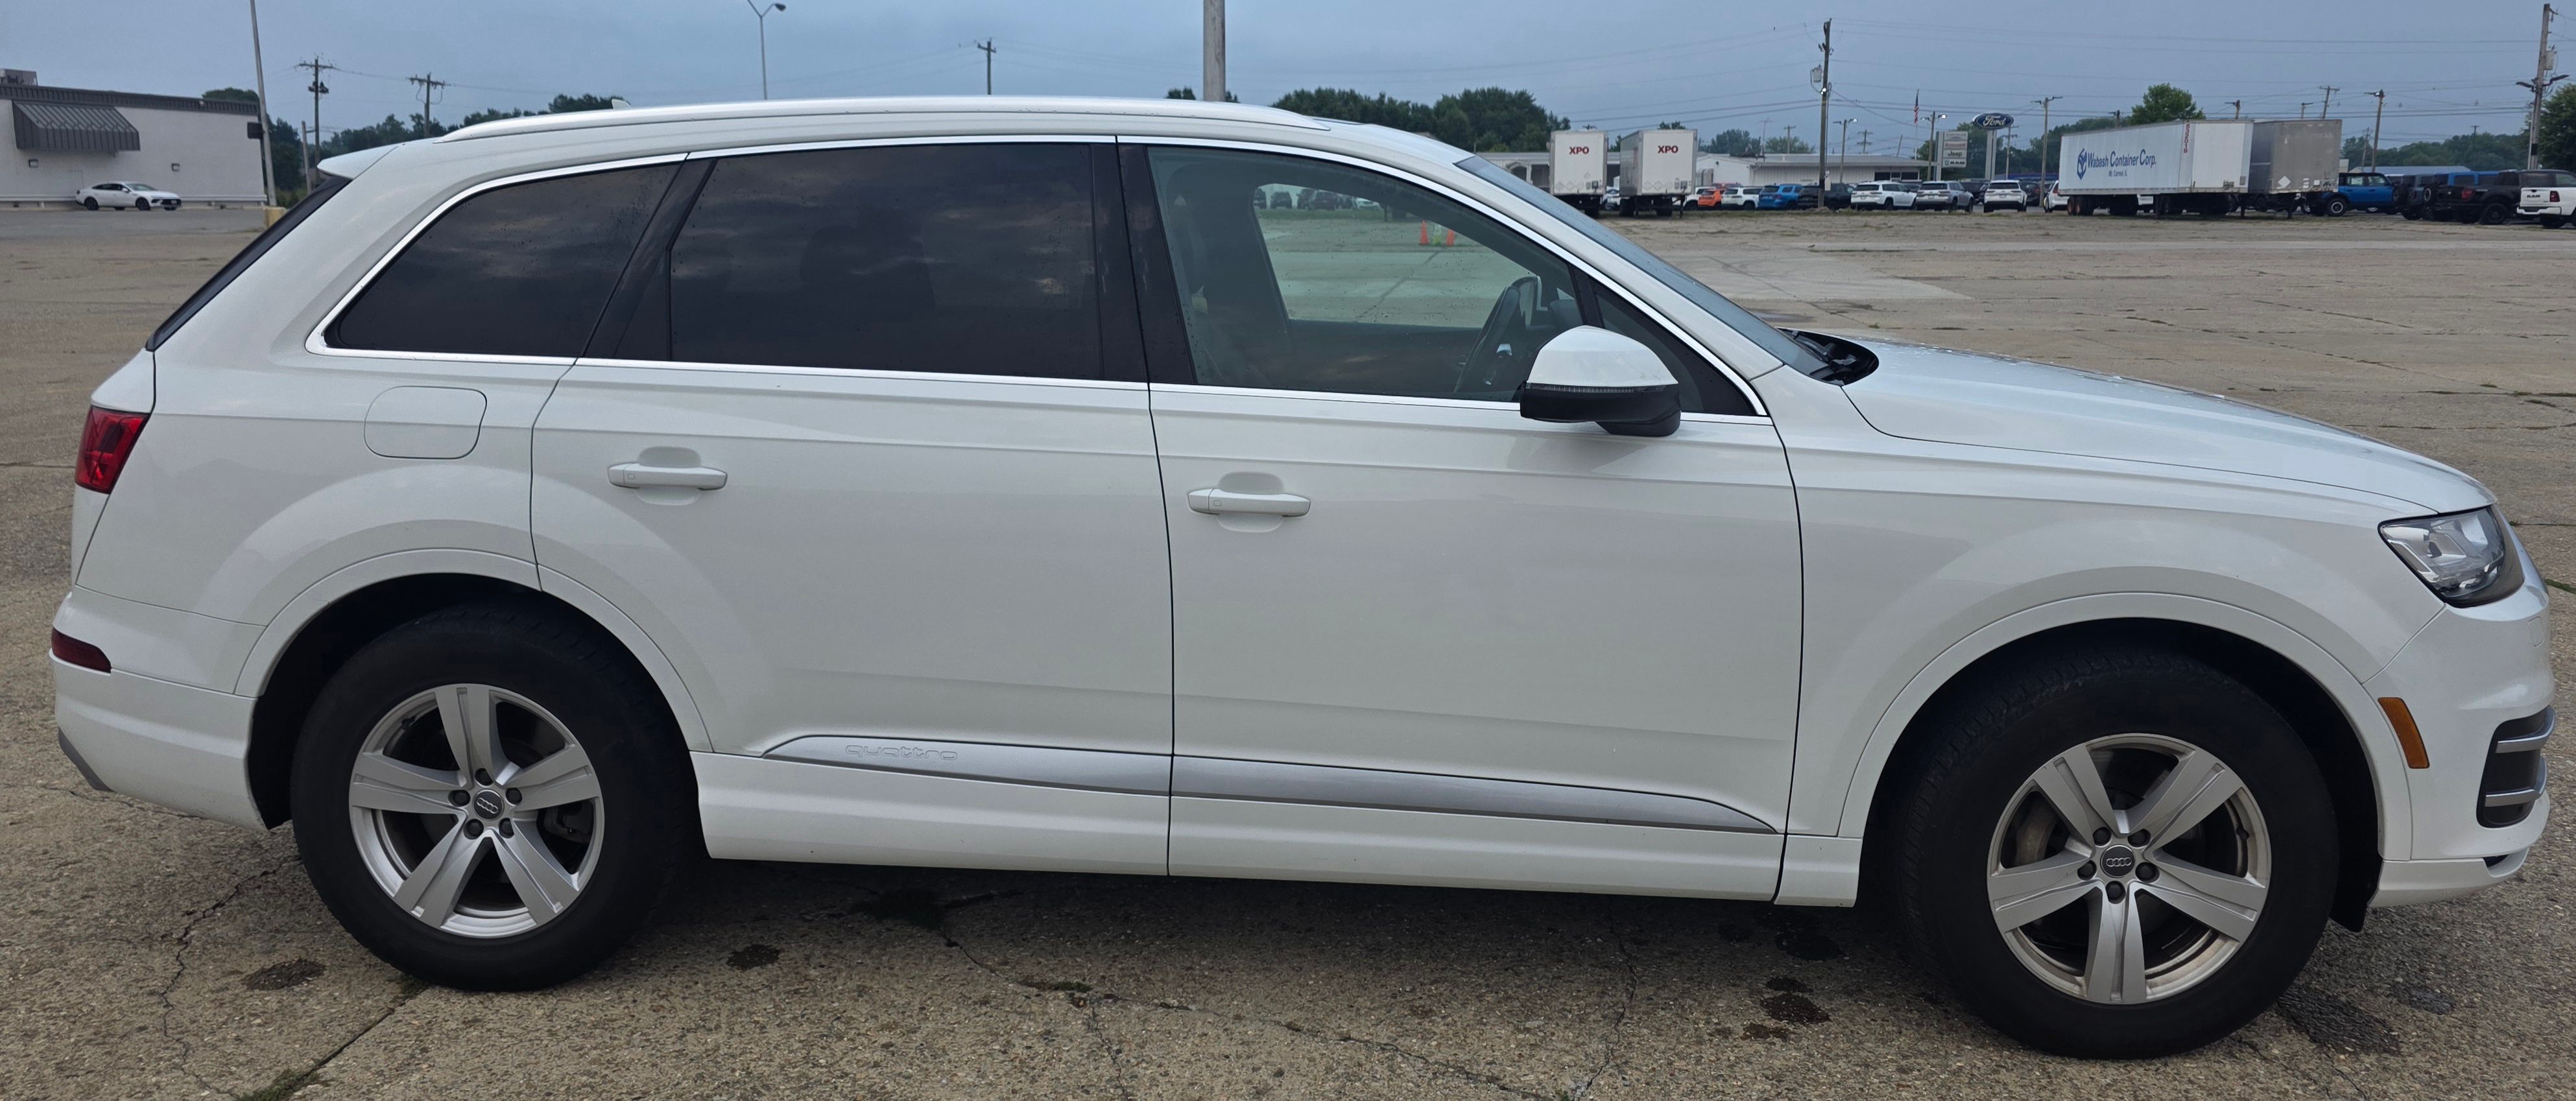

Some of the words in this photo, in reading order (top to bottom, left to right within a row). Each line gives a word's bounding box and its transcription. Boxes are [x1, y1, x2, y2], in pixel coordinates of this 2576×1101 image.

[1983, 115, 2007, 126] Ford
[1658, 145, 1678, 154] XPO
[2088, 152, 2108, 168] Wabash
[2110, 150, 2139, 167] Container
[2140, 148, 2156, 169] Corp.
[846, 744, 958, 761] quattro
